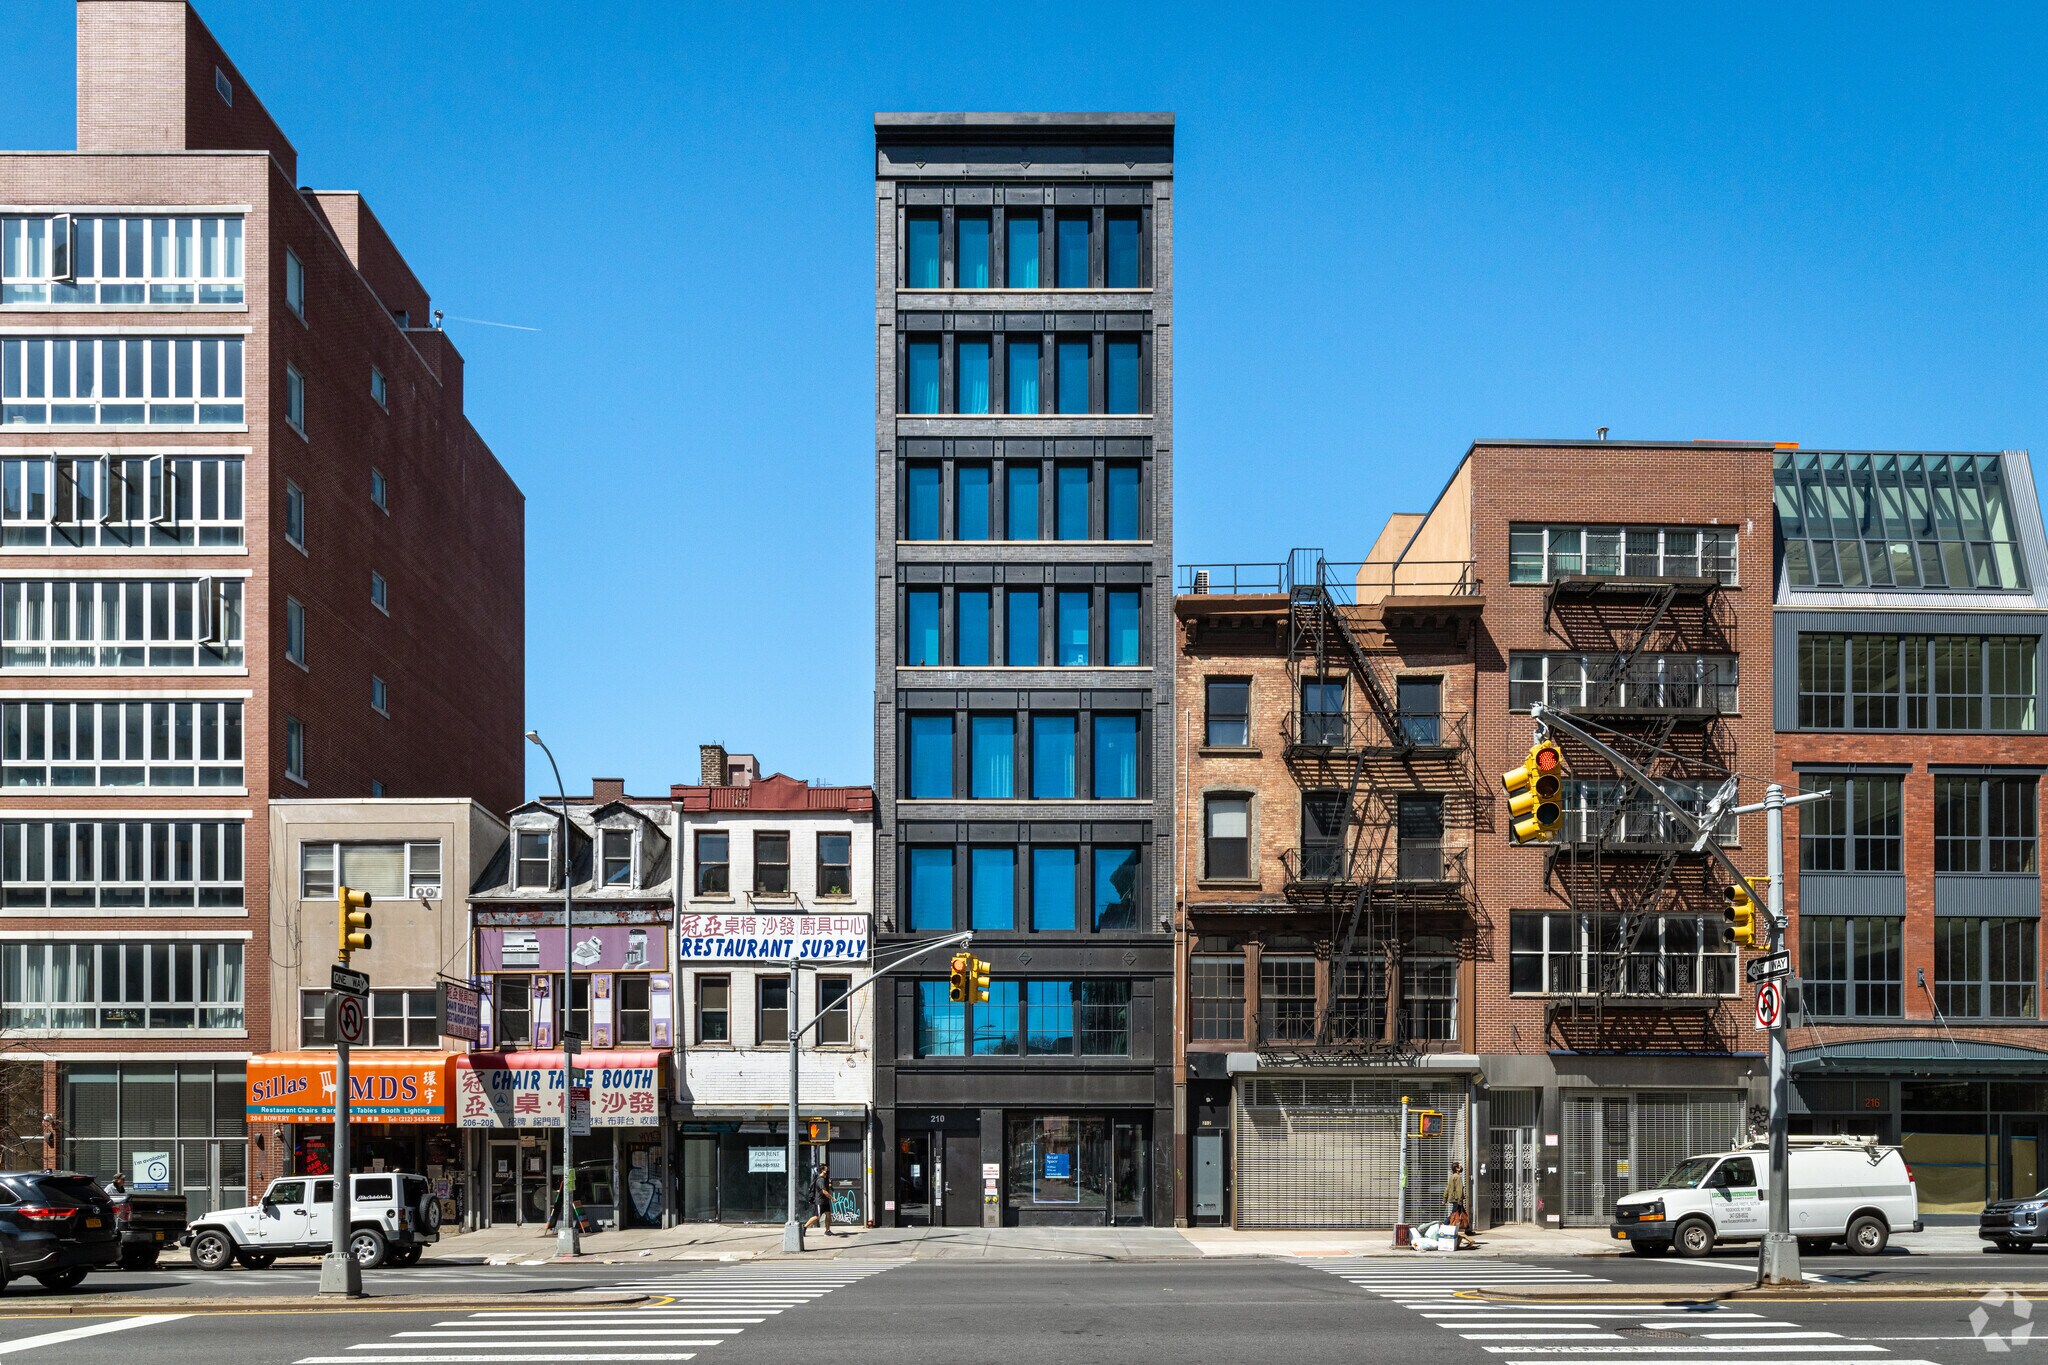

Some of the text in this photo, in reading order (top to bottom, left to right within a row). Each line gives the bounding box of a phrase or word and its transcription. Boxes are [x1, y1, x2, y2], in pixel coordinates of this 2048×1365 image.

[681, 914, 867, 938] 冠亞桌椅 沙發 廚具中心
[681, 938, 866, 958] RESTAURANT SUPPLY
[1752, 958, 1785, 975] ONE WAY
[335, 973, 365, 989] ONE WAY
[457, 1002, 467, 1014] TABLE
[467, 1005, 478, 1017] BOOTH
[252, 1074, 308, 1102] Sillas
[492, 1071, 540, 1091] CHAIR
[602, 1069, 653, 1089] BOOTH
[349, 1076, 417, 1101] MDS
[462, 1070, 489, 1118] 冠亞
[261, 1106, 296, 1114] Restaurant
[297, 1106, 318, 1114] Chairs
[357, 1106, 377, 1114] Tables
[381, 1106, 400, 1114] Booth
[403, 1106, 430, 1115] Lighting
[1865, 1098, 1880, 1108] 216
[463, 1119, 495, 1128] 206-208
[607, 1116, 635, 1126] 布菲台
[930, 1115, 945, 1123] 210
[143, 1153, 167, 1164] available!
